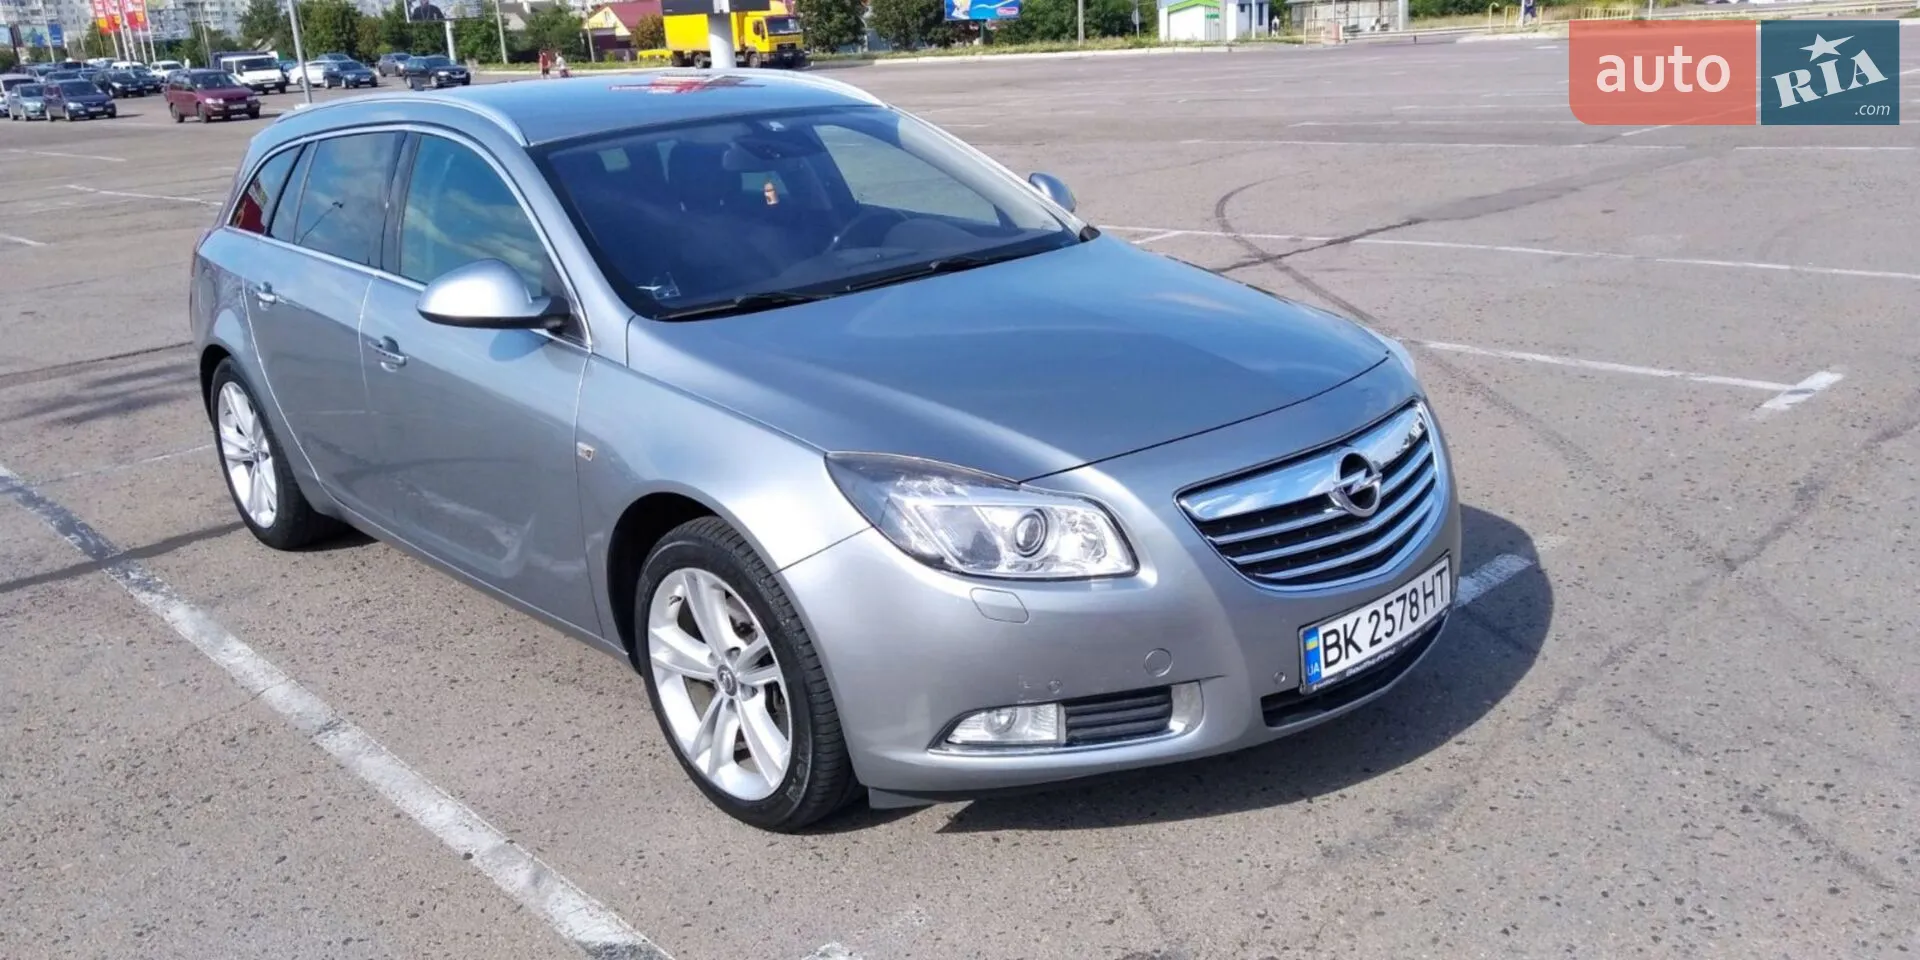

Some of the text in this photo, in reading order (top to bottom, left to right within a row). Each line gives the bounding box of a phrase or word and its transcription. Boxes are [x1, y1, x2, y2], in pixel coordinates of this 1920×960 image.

[1322, 617, 1362, 668] BK
[1368, 588, 1419, 647] 2578
[1422, 567, 1448, 614] HT
[1308, 662, 1320, 676] UA
